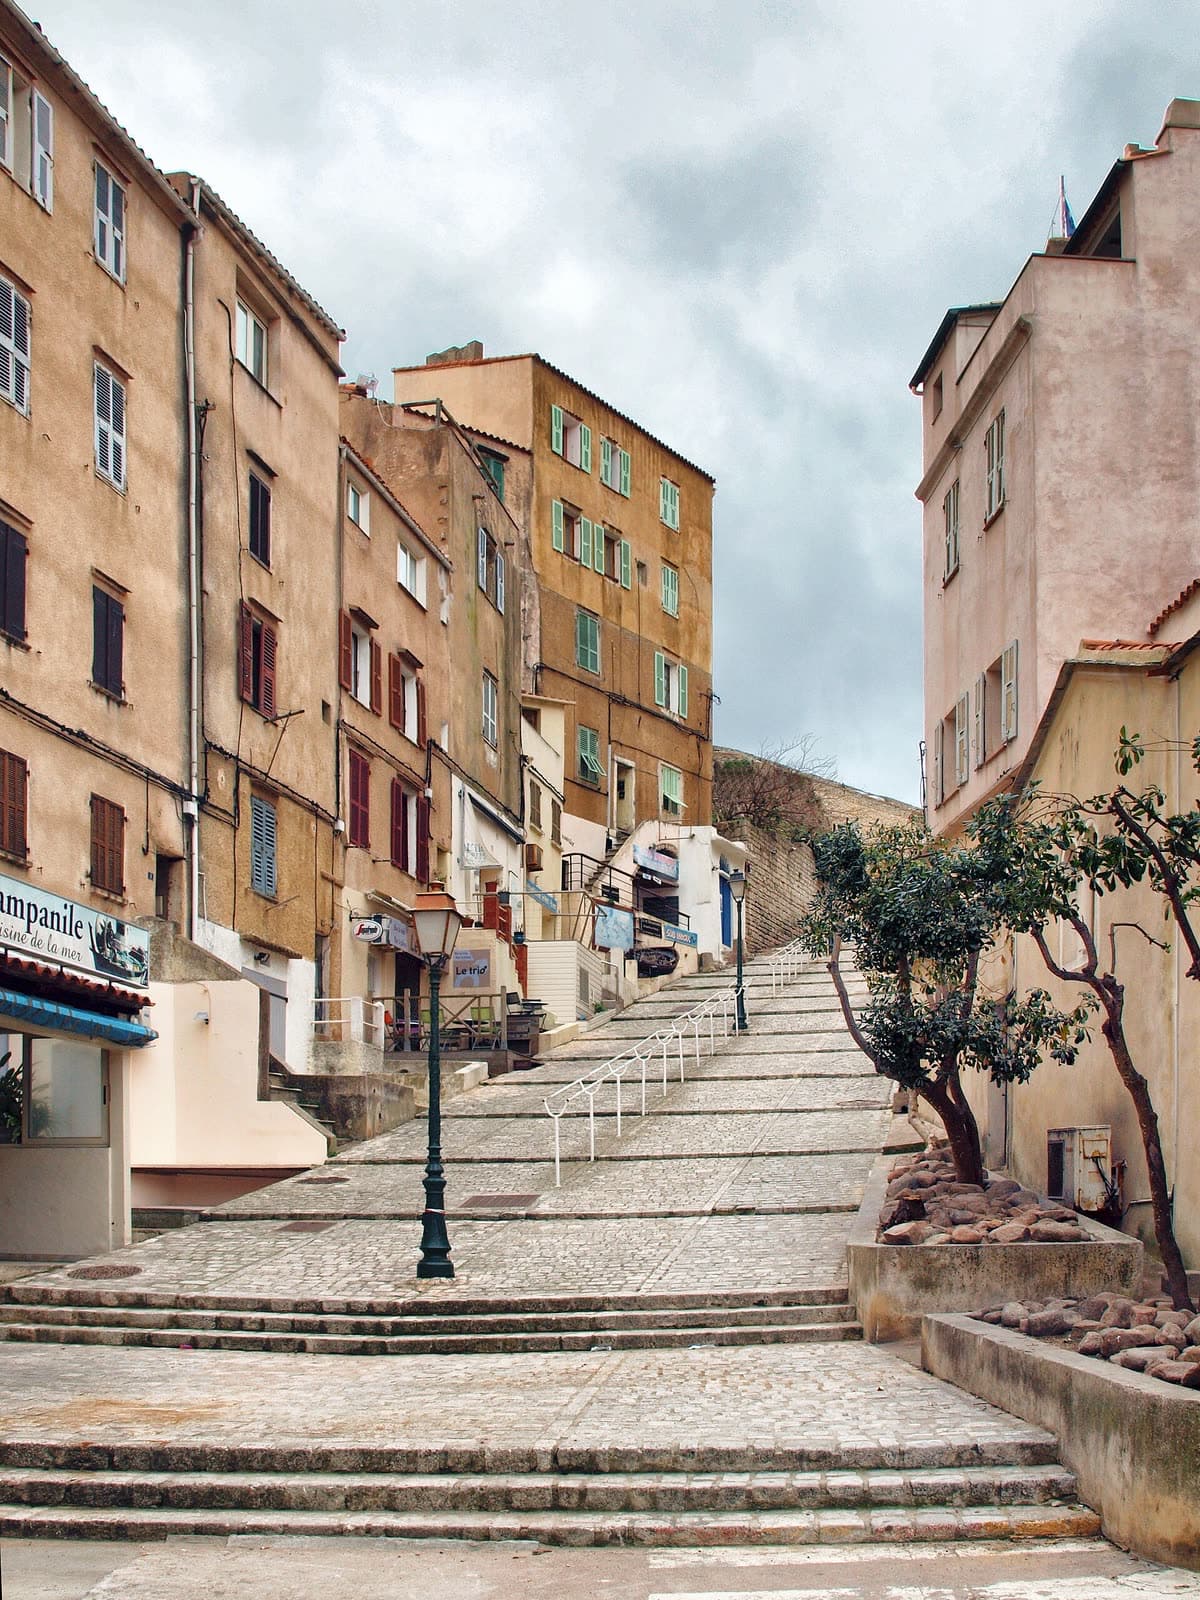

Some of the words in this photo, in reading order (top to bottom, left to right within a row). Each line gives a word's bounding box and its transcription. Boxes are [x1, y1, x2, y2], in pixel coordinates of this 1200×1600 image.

[30, 930, 44, 950] de
[47, 933, 59, 954] la
[61, 946, 82, 962] mer
[456, 966, 467, 975] Le
